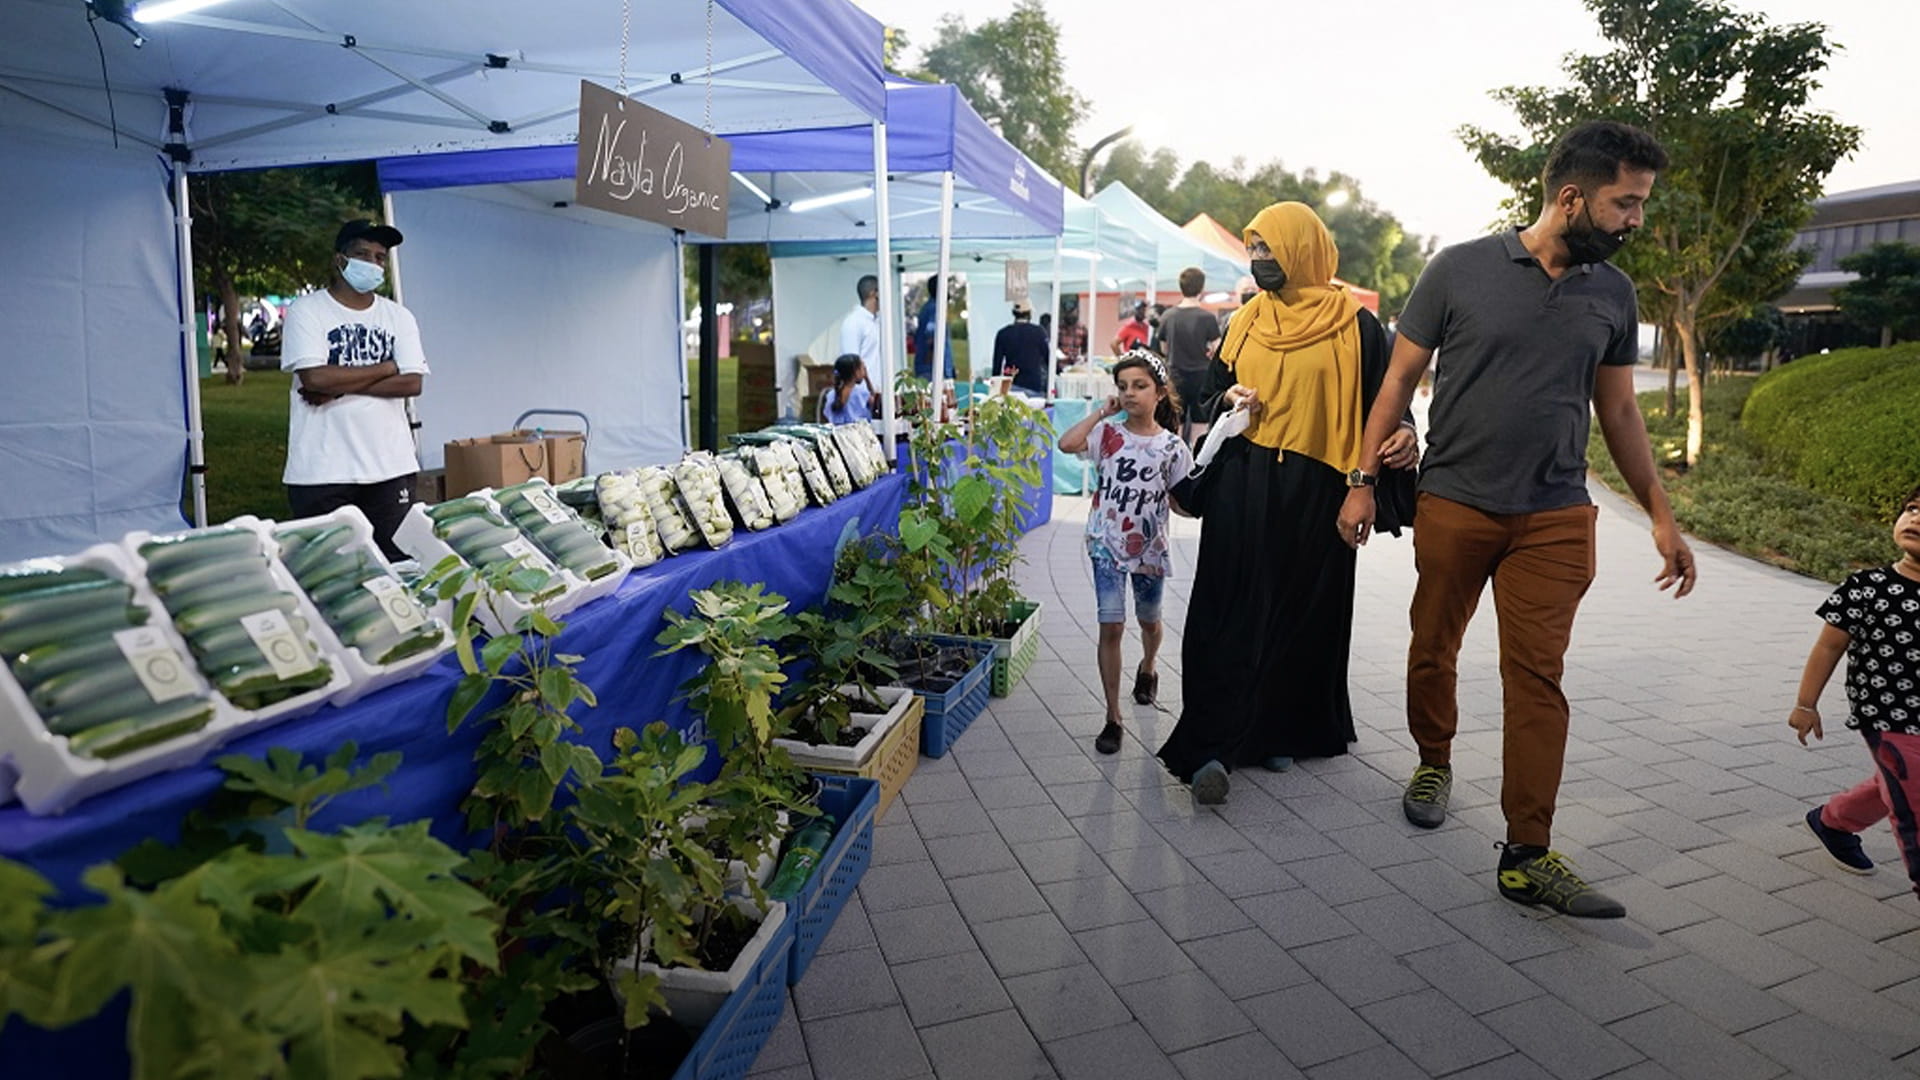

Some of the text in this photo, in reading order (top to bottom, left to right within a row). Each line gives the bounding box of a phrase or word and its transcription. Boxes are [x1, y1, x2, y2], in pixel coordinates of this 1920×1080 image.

[587, 113, 721, 215] Nayla Organic
[1115, 456, 1160, 483] Be
[1098, 474, 1166, 516] Happy
